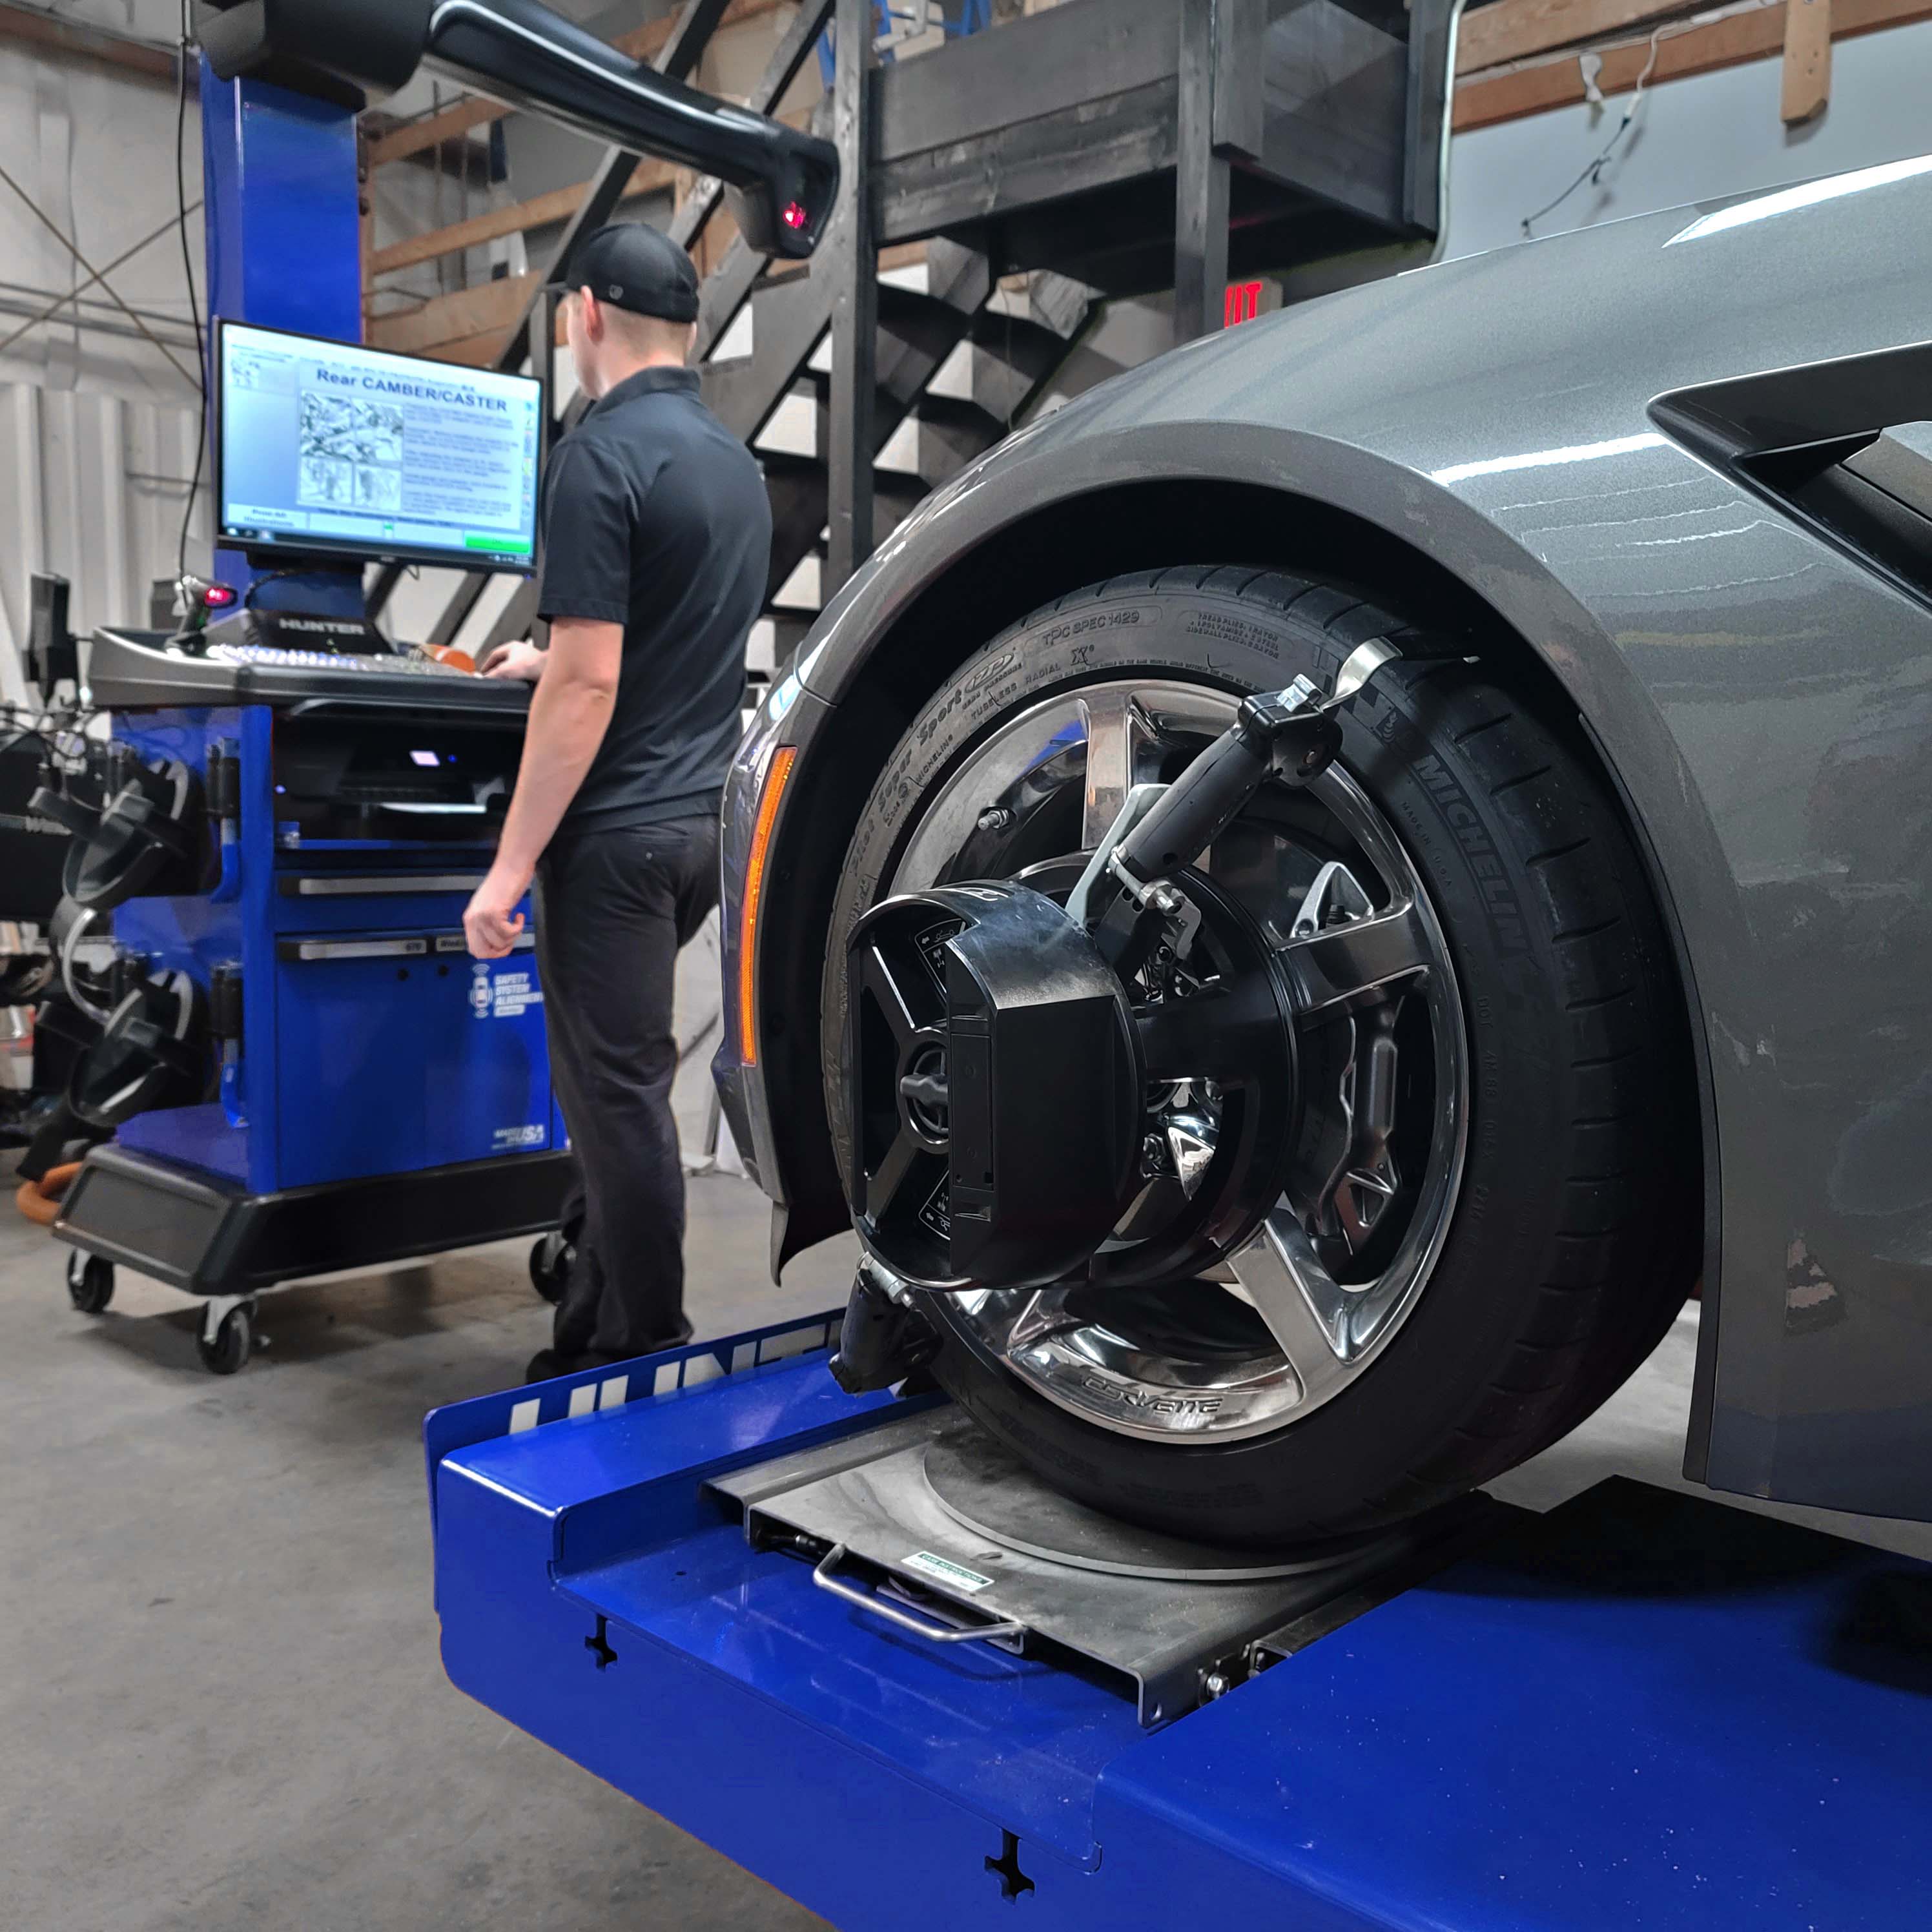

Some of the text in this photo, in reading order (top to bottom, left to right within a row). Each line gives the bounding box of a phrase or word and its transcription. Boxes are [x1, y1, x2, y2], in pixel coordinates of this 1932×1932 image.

[1224, 281, 1262, 328] IT
[316, 368, 356, 386] Rear
[362, 376, 508, 412] CAMBER/CASTER
[279, 618, 365, 635] HUNTER
[1073, 615, 1106, 634] SPEC
[1109, 610, 1140, 626] 1429
[971, 682, 1018, 721] TUBELESS
[1025, 663, 1060, 686] RADIAL
[916, 688, 962, 746] Sport
[1412, 754, 1532, 951] MICHELIN
